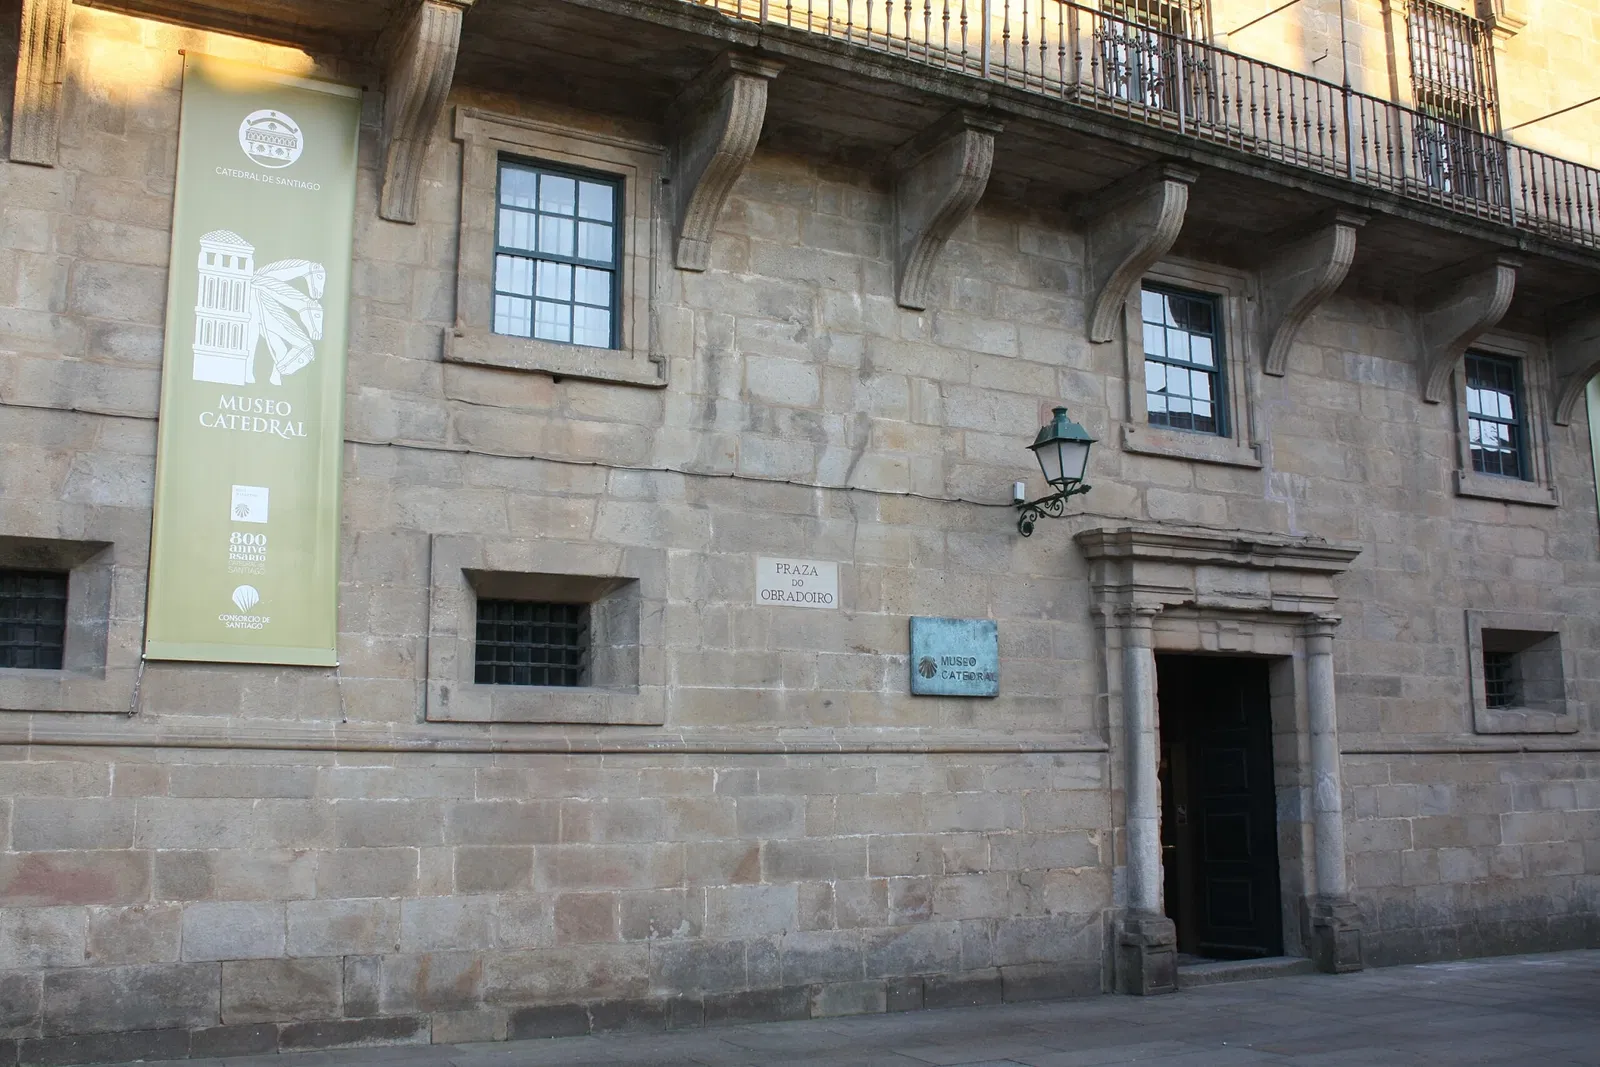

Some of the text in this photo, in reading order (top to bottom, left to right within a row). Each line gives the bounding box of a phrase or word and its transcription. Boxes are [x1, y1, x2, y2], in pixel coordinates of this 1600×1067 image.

[215, 166, 321, 191] CATEDRAL DE SANTIAGO
[218, 394, 292, 417] MUSEO
[199, 411, 308, 440] CATEDRAL
[229, 531, 267, 546] 800
[228, 565, 265, 576] SANTIAGO
[776, 562, 819, 577] PRAZA
[791, 579, 804, 587] DO
[761, 589, 833, 604] OBRADOIRO
[218, 614, 261, 623] CONSORCIO
[225, 621, 263, 630] SANTIAGO
[941, 656, 977, 667] MUSEO
[941, 670, 997, 682] CATEDRAL
